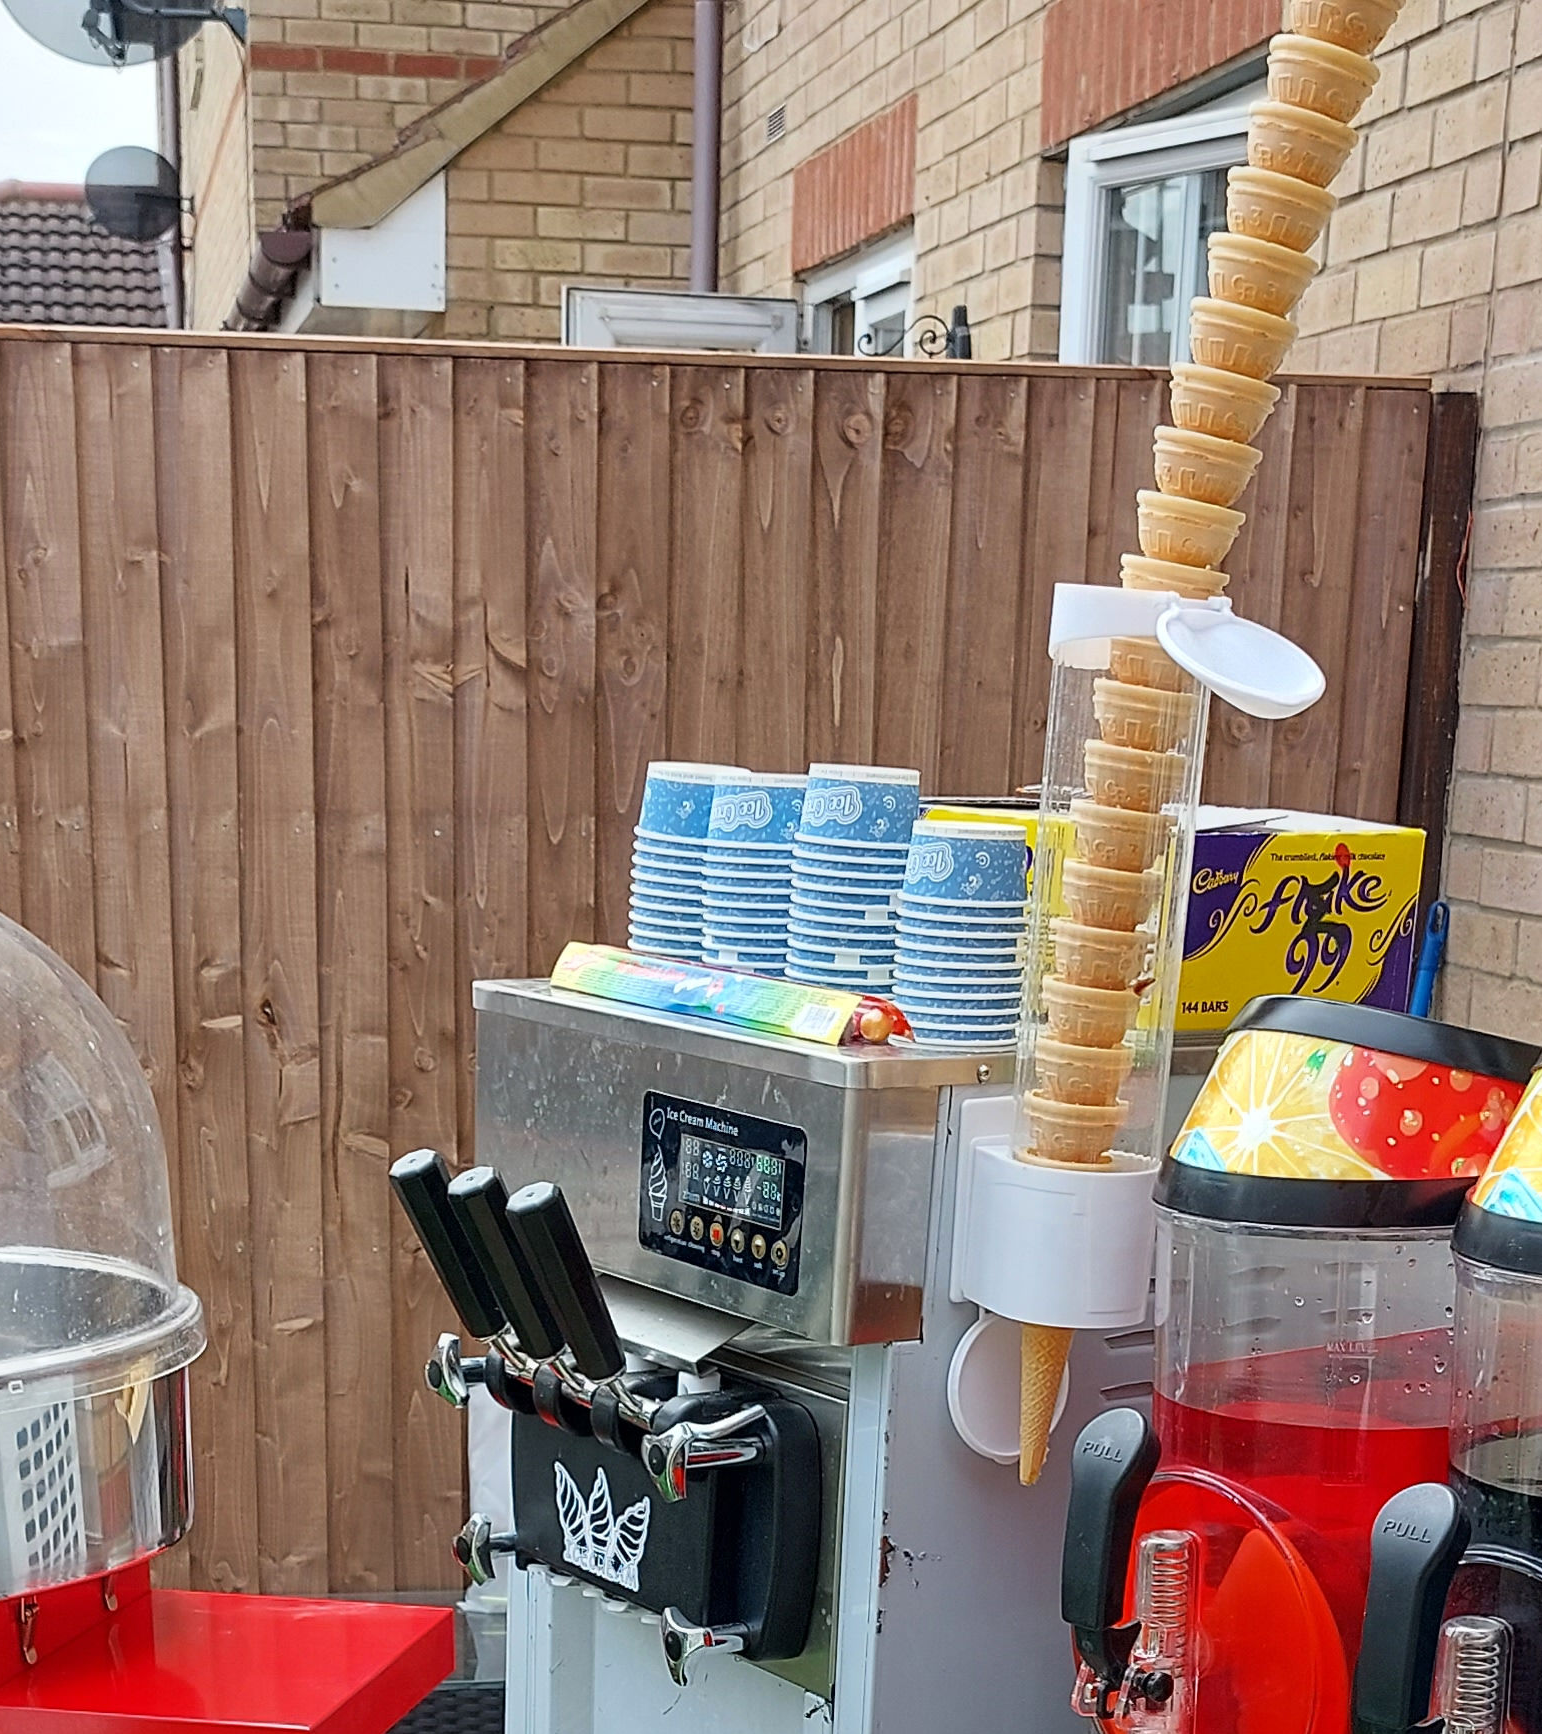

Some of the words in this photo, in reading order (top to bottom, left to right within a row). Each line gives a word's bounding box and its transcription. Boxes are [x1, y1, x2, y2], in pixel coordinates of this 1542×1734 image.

[1193, 868, 1240, 895] Cadbury
[1181, 1001, 1200, 1014] 144
[1201, 1000, 1229, 1014] BARS
[666, 1107, 678, 1121] Ice
[679, 1110, 704, 1127] Cream
[705, 1117, 739, 1136] Machine
[1082, 1440, 1123, 1463] PULL
[1382, 1520, 1431, 1544] PULL
